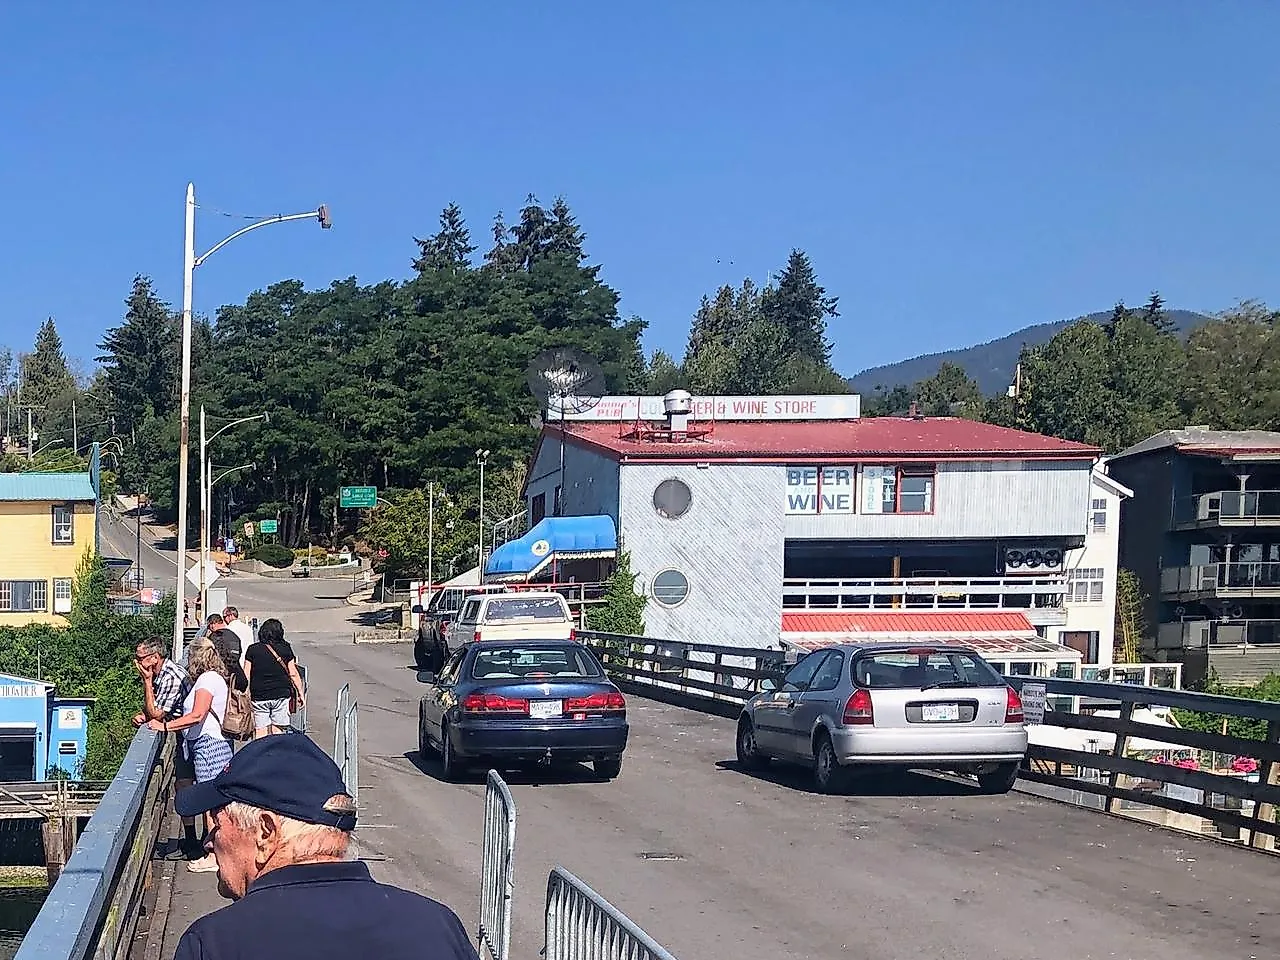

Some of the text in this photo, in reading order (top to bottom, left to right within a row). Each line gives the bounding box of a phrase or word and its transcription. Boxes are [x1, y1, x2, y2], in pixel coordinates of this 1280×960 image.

[596, 408, 621, 417] PUB
[732, 401, 768, 415] WINE
[775, 400, 817, 414] STORE
[787, 469, 850, 486] BEER
[786, 494, 850, 510] WINE
